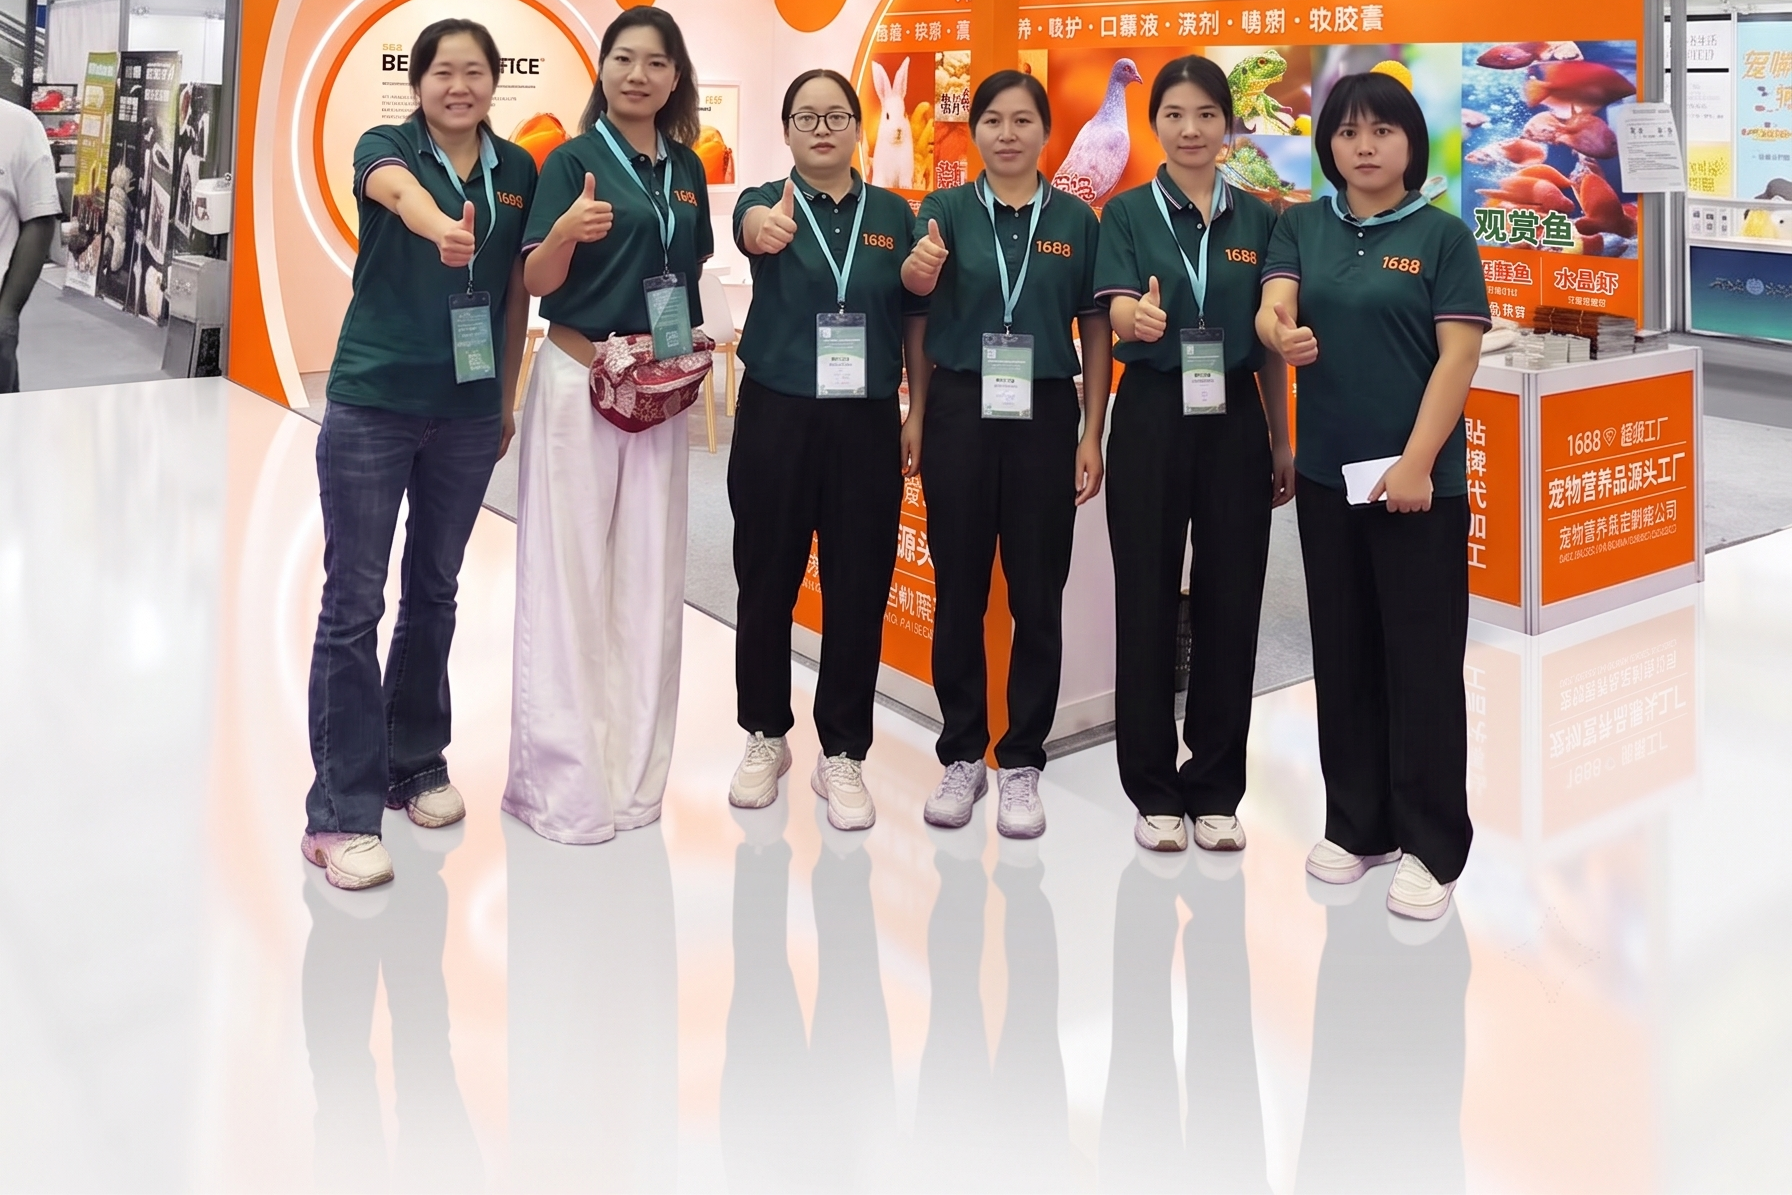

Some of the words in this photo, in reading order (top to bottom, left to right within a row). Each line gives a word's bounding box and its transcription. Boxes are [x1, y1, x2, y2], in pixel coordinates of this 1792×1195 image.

[1474, 207, 1575, 247] 观赏鱼
[862, 233, 894, 250] 1688
[1225, 248, 1258, 265] 1688
[1382, 255, 1421, 275] 1688
[1567, 429, 1601, 456] 1688
[1548, 452, 1685, 510] 宠物营养品源头工厂
